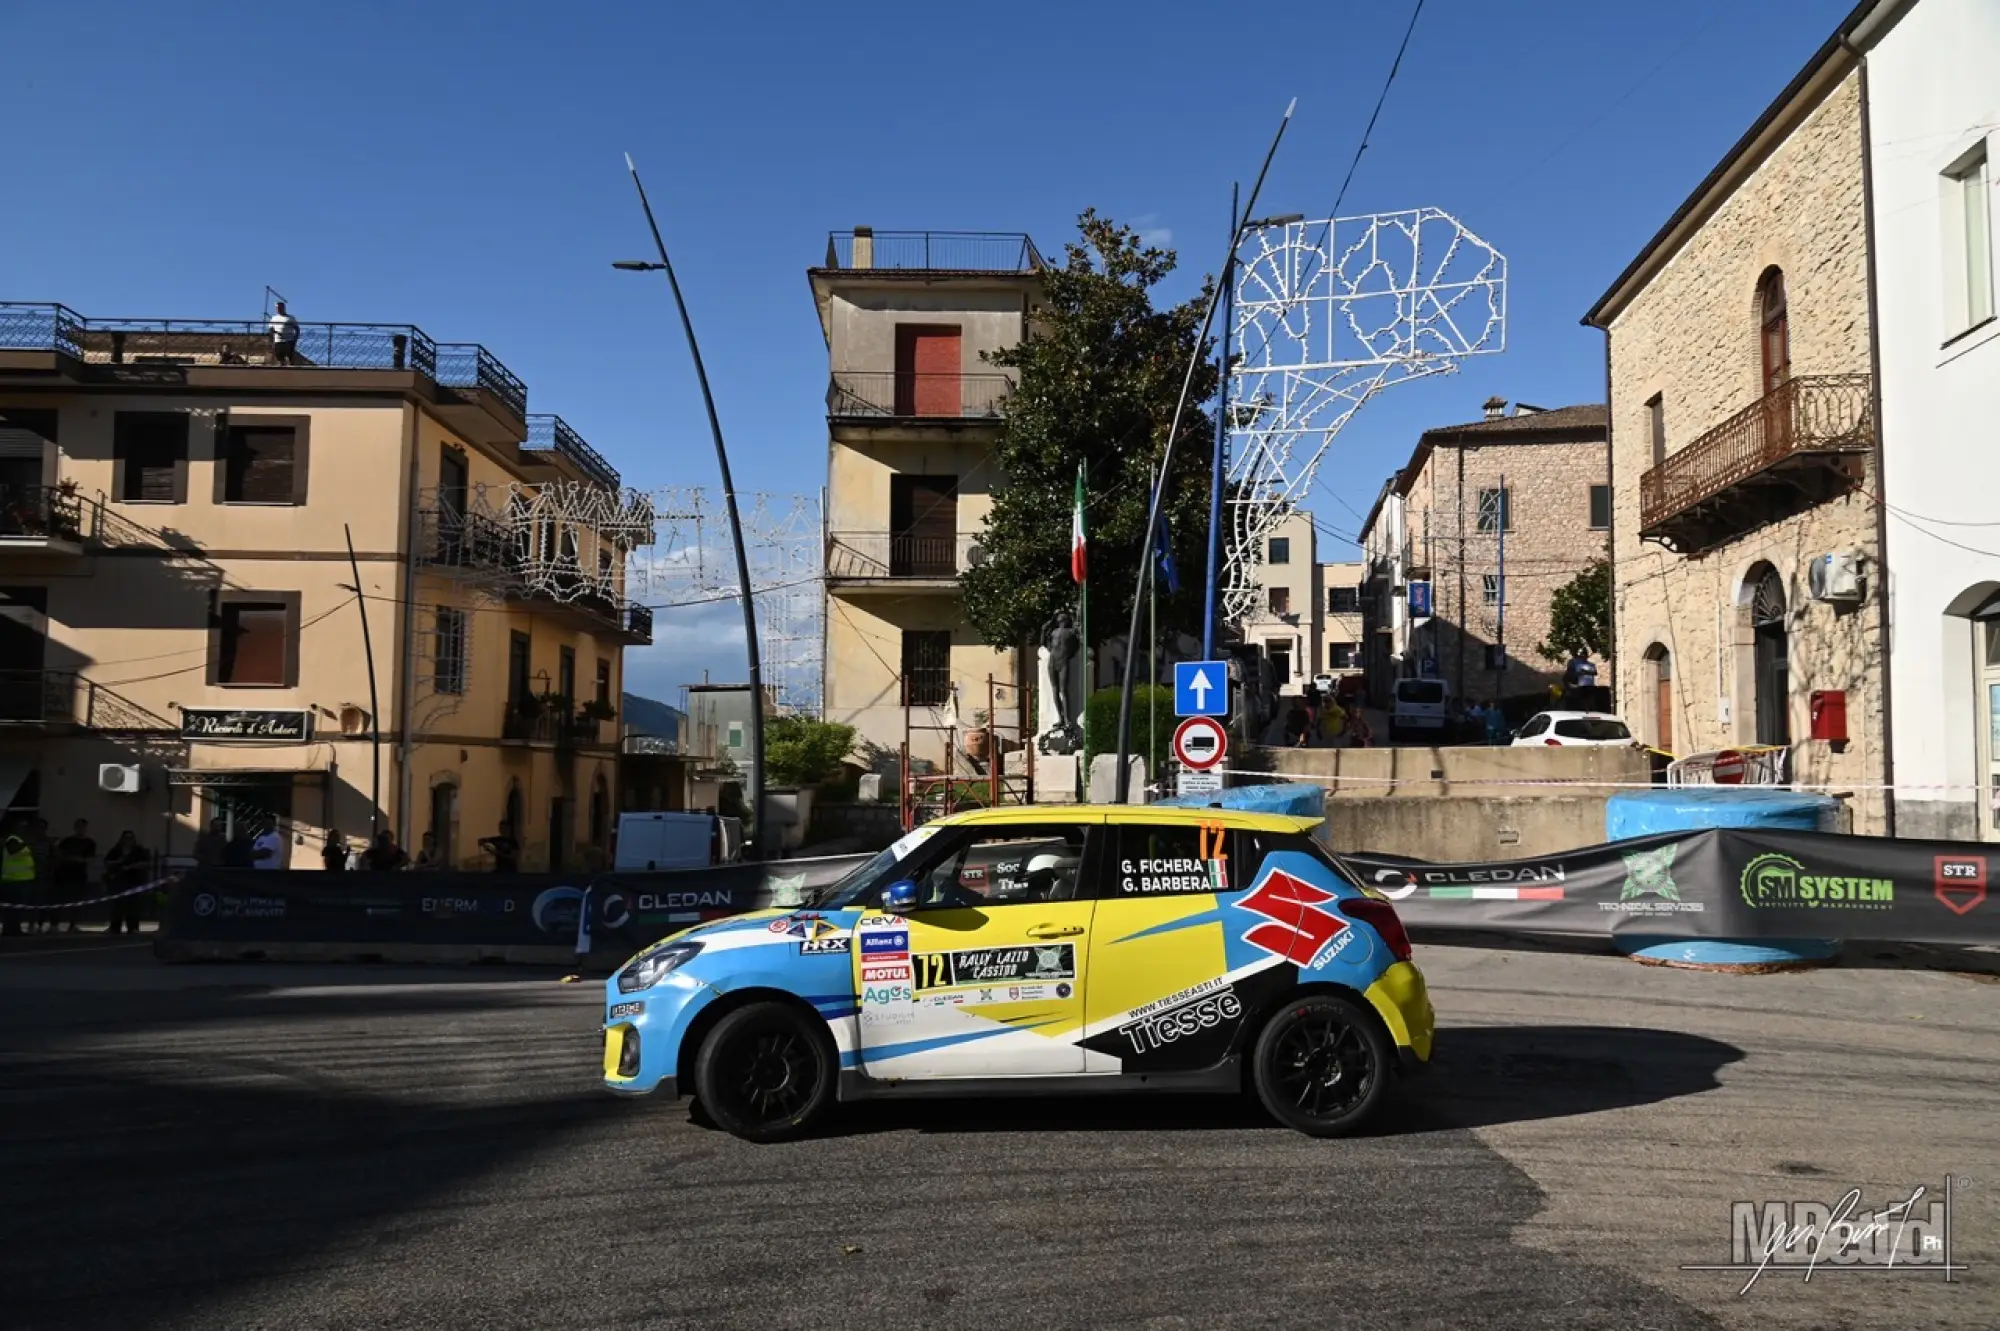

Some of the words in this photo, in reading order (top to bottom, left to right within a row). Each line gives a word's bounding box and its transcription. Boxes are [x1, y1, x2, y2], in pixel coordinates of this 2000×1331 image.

[1193, 818, 1228, 861] 72
[1121, 859, 1137, 873] G.
[1140, 858, 1204, 873] FICHERA
[1425, 864, 1565, 882] CLEDAN
[1943, 864, 1977, 876] STR
[1122, 877, 1139, 892] G.
[1141, 876, 1212, 891] BARBERA
[1759, 873, 1795, 899] SM
[1800, 876, 1893, 901] SYSTEM
[639, 890, 732, 910] CLEDAN
[1598, 902, 1655, 912] TECHNICAL
[1656, 902, 1704, 912] SERVICES
[802, 939, 846, 951] HRX
[866, 938, 892, 946] Allianz
[1313, 930, 1355, 971] SUZUKI
[959, 953, 992, 968] RALLY
[996, 950, 1029, 964] LAZIO
[865, 968, 908, 980] MOTUL
[918, 953, 947, 988] 72
[973, 963, 1018, 979] CASSINO
[864, 985, 911, 1005] Agos
[1120, 986, 1241, 1054] Tiesse
